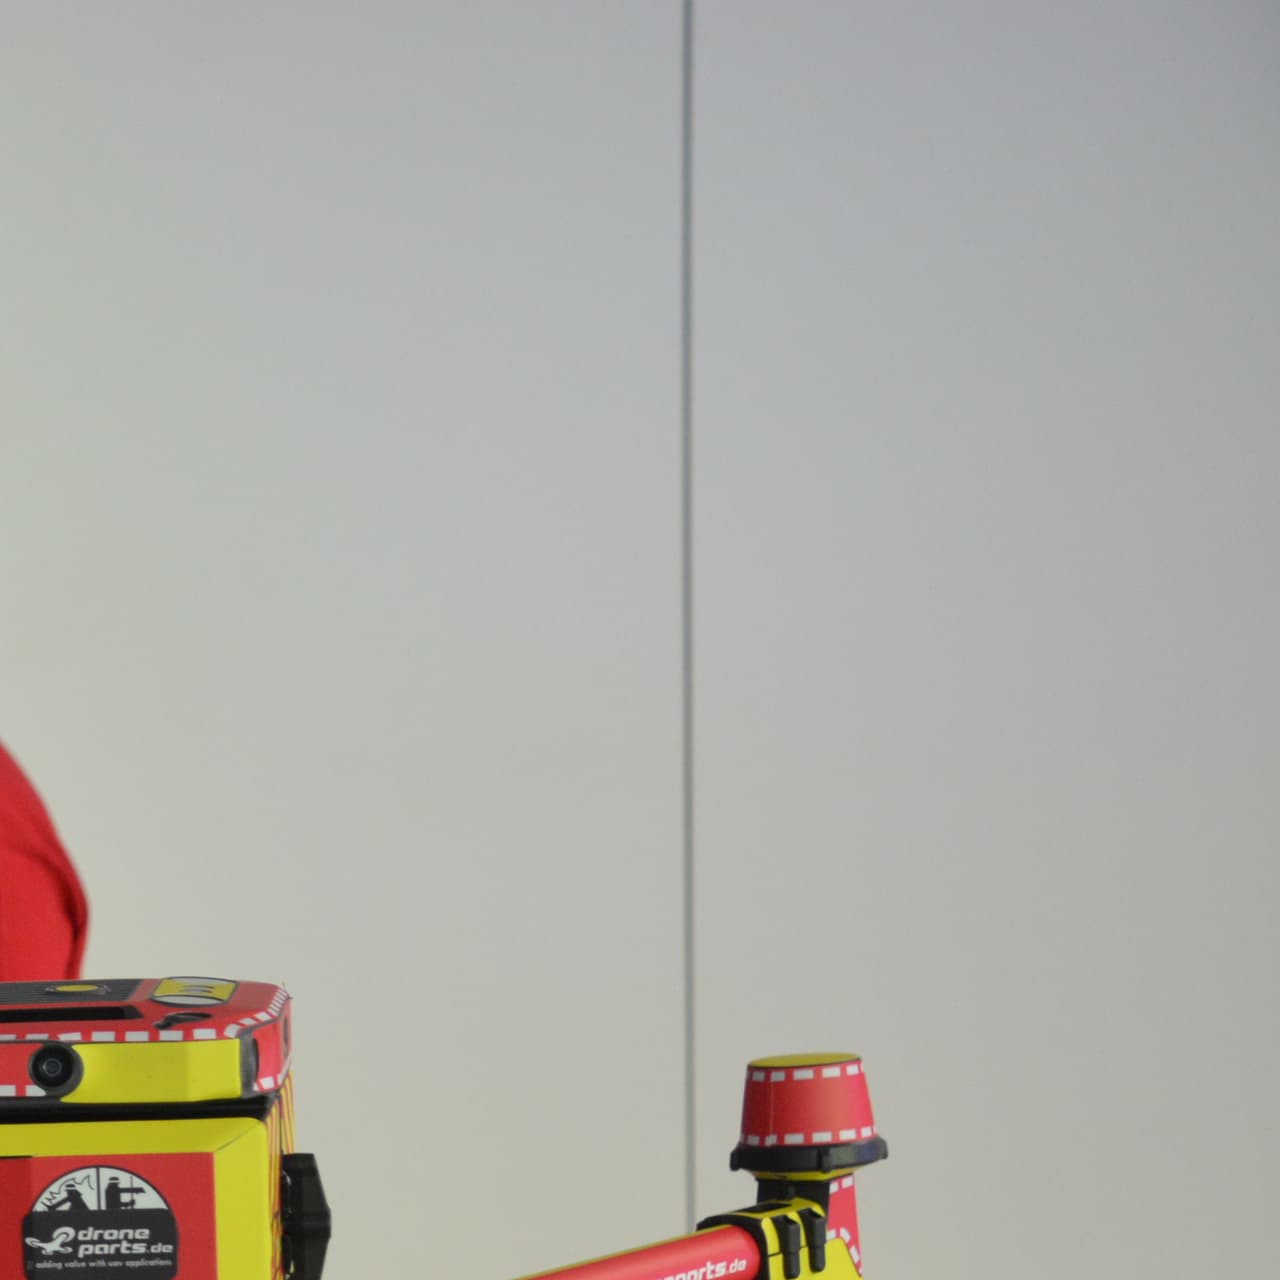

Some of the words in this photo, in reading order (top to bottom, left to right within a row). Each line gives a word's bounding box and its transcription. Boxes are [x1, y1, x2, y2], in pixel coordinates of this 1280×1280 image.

[77, 1227, 150, 1241] drone
[77, 1240, 174, 1258] parts.de
[35, 1260, 63, 1270] adding
[64, 1259, 87, 1268] value
[88, 1258, 106, 1268] with
[125, 1258, 173, 1270] applications
